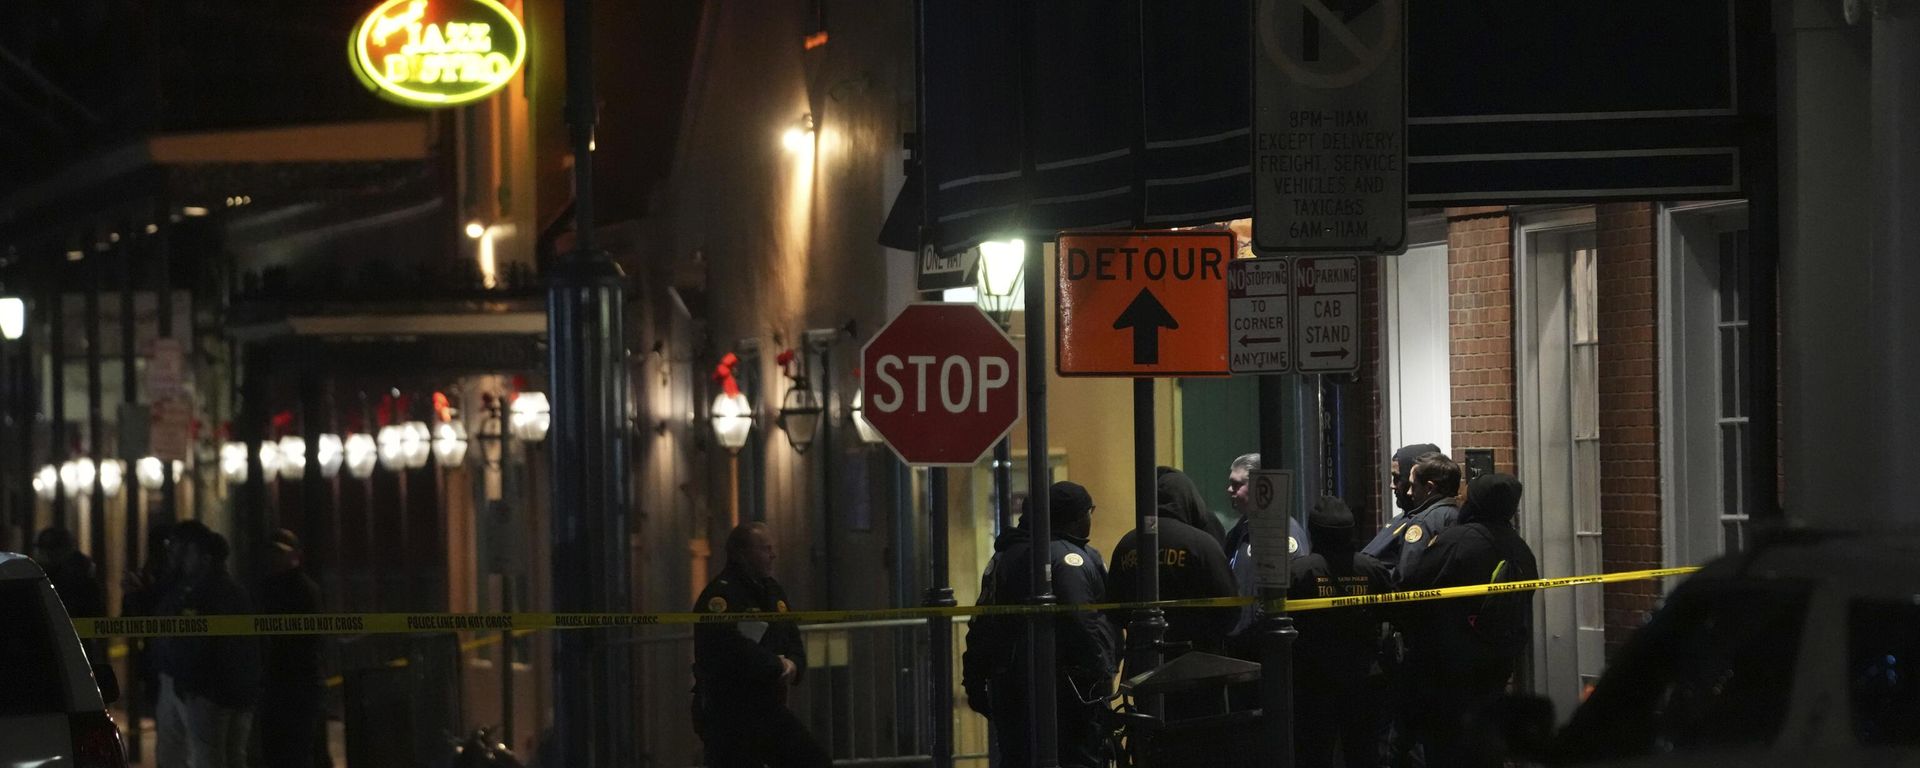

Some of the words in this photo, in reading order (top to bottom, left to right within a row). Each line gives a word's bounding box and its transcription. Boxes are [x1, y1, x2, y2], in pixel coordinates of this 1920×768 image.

[400, 22, 492, 54] JAZZ
[1258, 132, 1316, 150] EXCEPT
[1334, 154, 1397, 172] SERVICE
[1273, 176, 1345, 194] VEHICLES
[1354, 176, 1384, 193] AND
[1293, 198, 1365, 216] TAXICABS
[1068, 247, 1222, 281] DETOUR
[1229, 270, 1246, 290] NO
[1246, 271, 1287, 286] STOPPING
[1298, 267, 1314, 288] NO
[1314, 269, 1356, 283] PARKING
[1251, 300, 1266, 312] TO
[1314, 300, 1341, 318] CAB
[1234, 316, 1284, 331] CORNER
[1306, 325, 1350, 344] STAND
[1233, 351, 1287, 366] ANYTIME
[873, 354, 1010, 414] STOP
[1120, 548, 1185, 570] HOCIDE
[1318, 585, 1369, 597] HOCIDE
[94, 619, 125, 634] POLICE
[126, 619, 144, 633] LINE
[146, 619, 158, 633] DO
[160, 618, 176, 633] NOT
[178, 618, 208, 633] CROSS
[254, 617, 283, 632] POLICE
[284, 617, 303, 631] LINE
[303, 616, 315, 631] DO
[317, 616, 333, 630] NOT
[335, 616, 364, 630] CROSS
[407, 616, 436, 629] POLICE
[436, 615, 455, 629] LINE
[455, 615, 467, 628] DO
[468, 615, 484, 628] NOT
[485, 615, 512, 628] CROSS
